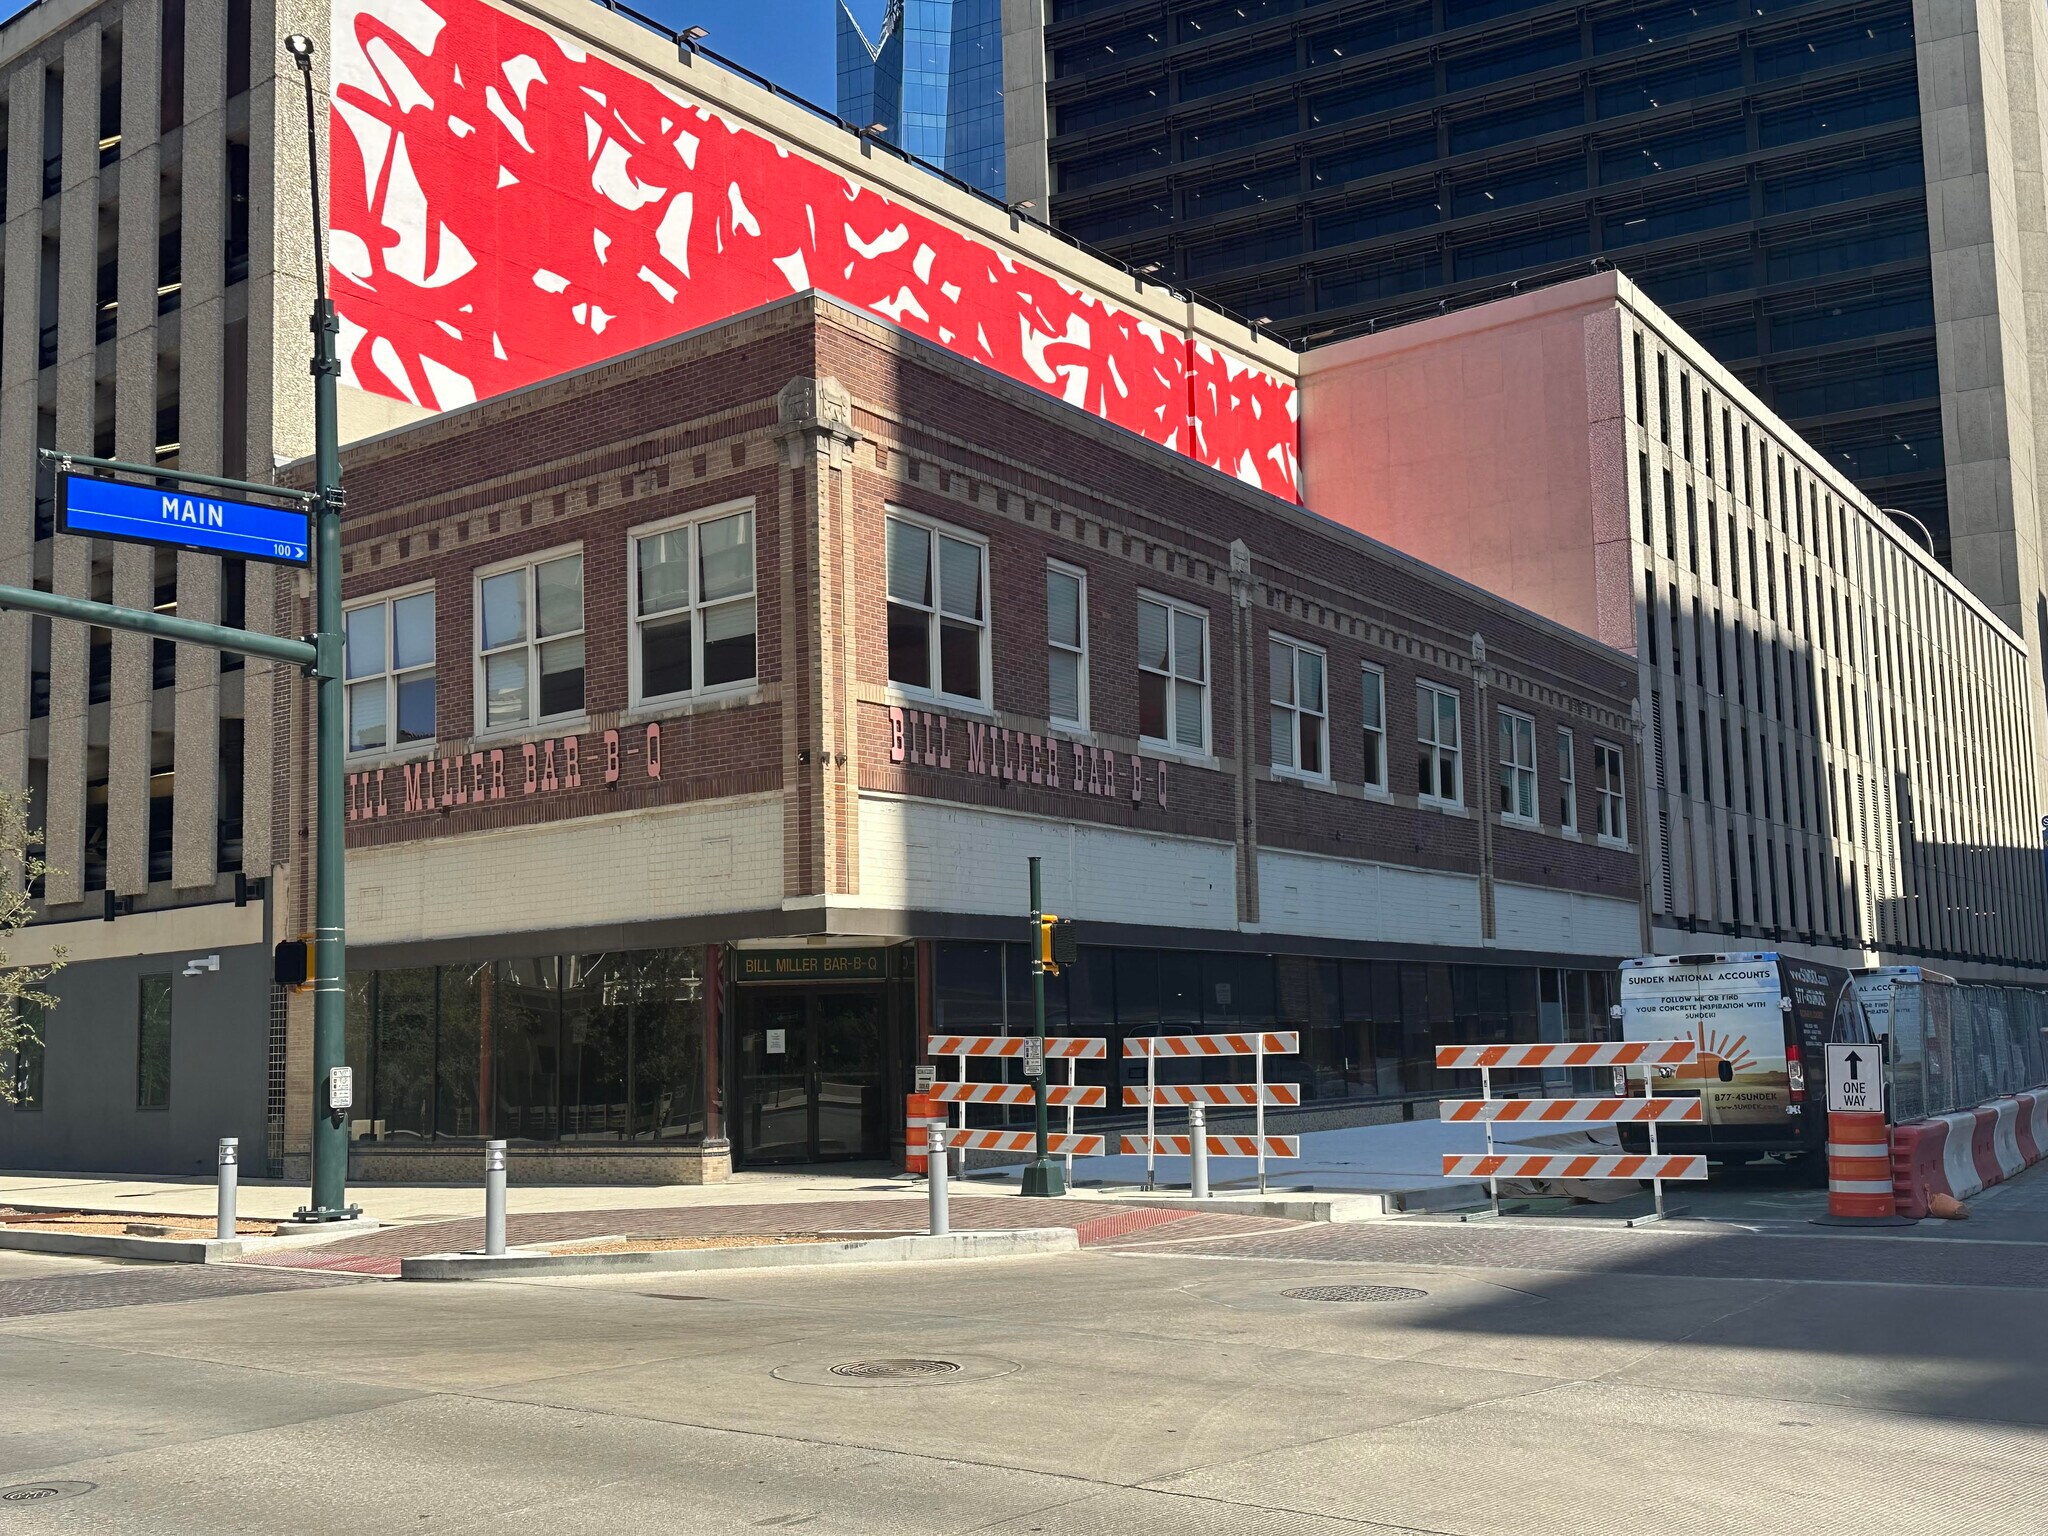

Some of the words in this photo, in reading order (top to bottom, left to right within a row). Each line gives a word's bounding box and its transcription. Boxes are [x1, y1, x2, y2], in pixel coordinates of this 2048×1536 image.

[162, 496, 223, 528] MAIN
[273, 543, 291, 557] 100
[889, 706, 950, 769] BILL
[967, 721, 1059, 788] MILLER
[1073, 743, 1168, 812] BAR-B-Q
[350, 769, 388, 820] ILL
[403, 749, 506, 812] MILLER
[522, 722, 662, 794] BAR-B-Q
[746, 959, 771, 973] BILL
[776, 958, 818, 972] MILLER
[823, 956, 877, 971] BAR-B-Q
[1628, 975, 1665, 985] SUNDEK
[1668, 973, 1714, 983] NATIONAL
[1718, 970, 1771, 980] ACCOUNTS
[1661, 995, 1692, 1003] FOLLOW
[1708, 994, 1719, 1002] OR
[1659, 1004, 1697, 1012] CONCRETE
[1700, 1002, 1744, 1010] INSPIRATION
[1843, 1082, 1866, 1094] ONE
[1714, 1092, 1777, 1102] 877-4SUNDEK
[1843, 1095, 1866, 1107] WAY
